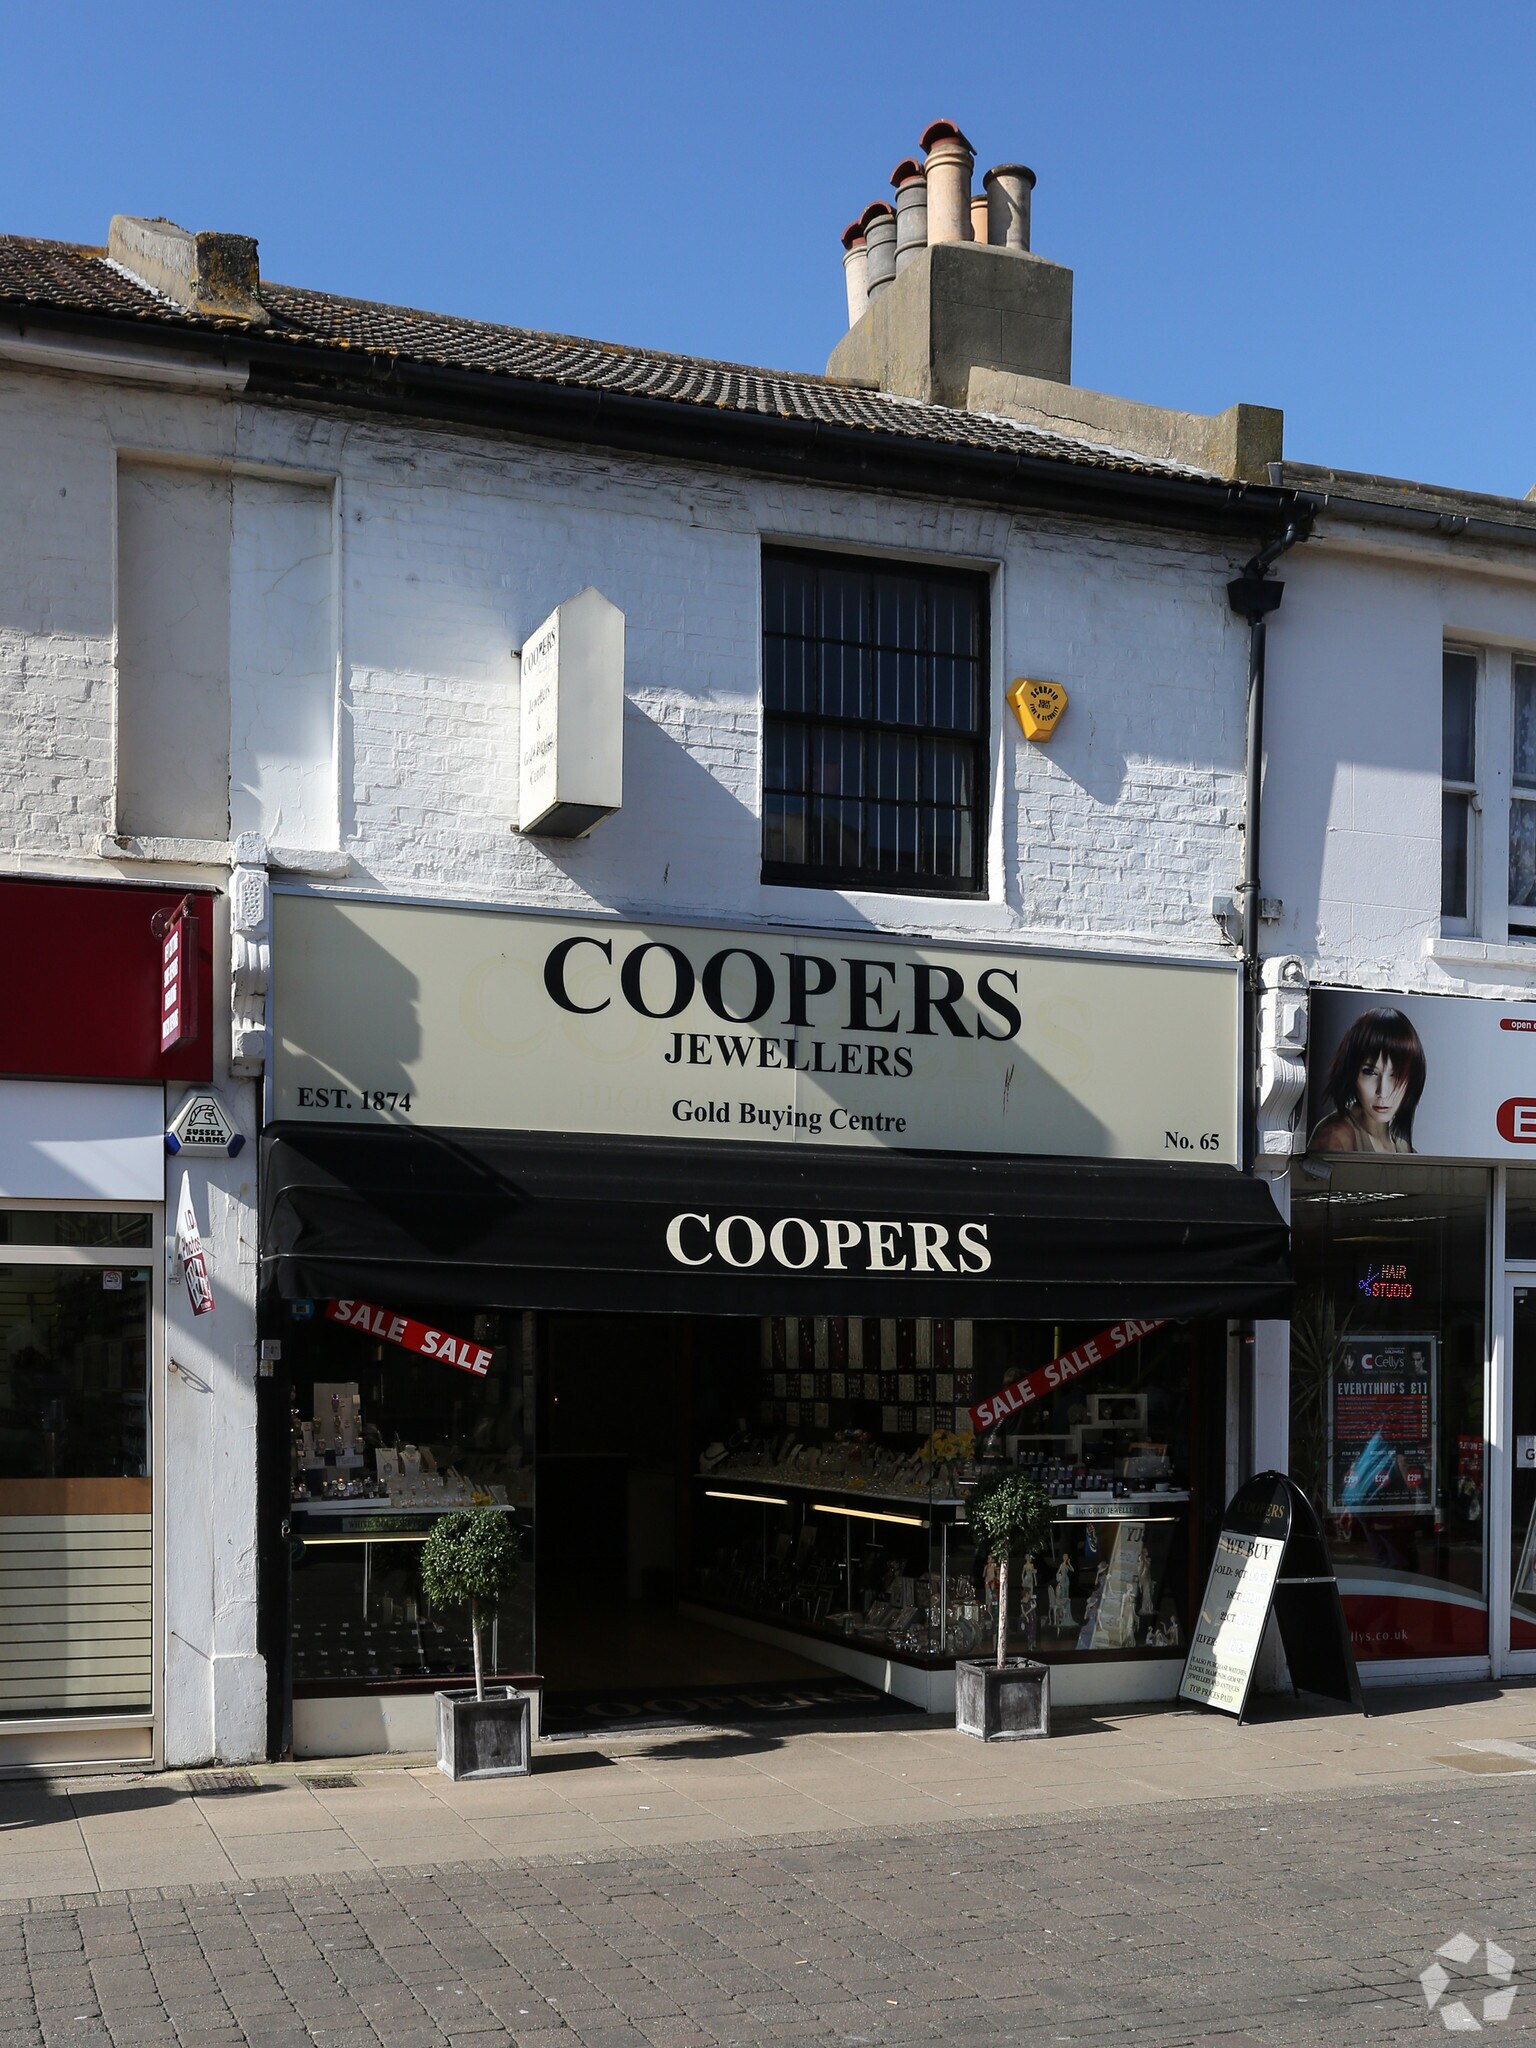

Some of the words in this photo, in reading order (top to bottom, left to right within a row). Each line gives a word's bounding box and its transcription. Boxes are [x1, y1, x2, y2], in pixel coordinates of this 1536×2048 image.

[524, 627, 557, 676] COOPERS
[1030, 686, 1059, 701] SCORPIO
[543, 936, 1023, 1041] COOPERS
[1511, 1020, 1532, 1031] open
[664, 1031, 914, 1078] JEWELLERS
[297, 1087, 352, 1110] EST.
[361, 1090, 411, 1112] 1874
[672, 1099, 730, 1123] Gold
[739, 1102, 822, 1134] Buying
[829, 1107, 907, 1134] Centre
[184, 1136, 226, 1144] ALARMS
[186, 1128, 224, 1136] SUSSEX
[1164, 1131, 1194, 1150] No.
[1199, 1132, 1220, 1151] 65
[181, 1235, 202, 1258] Photos
[665, 1212, 992, 1274] COOPERS
[1381, 1265, 1407, 1279] HAIR
[1372, 1282, 1413, 1298] STUDIO
[334, 1299, 408, 1342] SALE
[420, 1330, 493, 1375] SALE
[1374, 1354, 1405, 1374] Celly's
[976, 1379, 1036, 1426] SALE
[1044, 1341, 1102, 1387] SALE
[1337, 1382, 1405, 1395] EVERYTHING'S
[1410, 1382, 1428, 1394] £11
[1226, 1538, 1244, 1555] WE
[1247, 1541, 1273, 1561] BUY
[543, 1687, 881, 1721] COOPERS
[1189, 1684, 1201, 1694] TOP
[1201, 1687, 1220, 1700] PRICES
[1220, 1692, 1234, 1704] PAID
